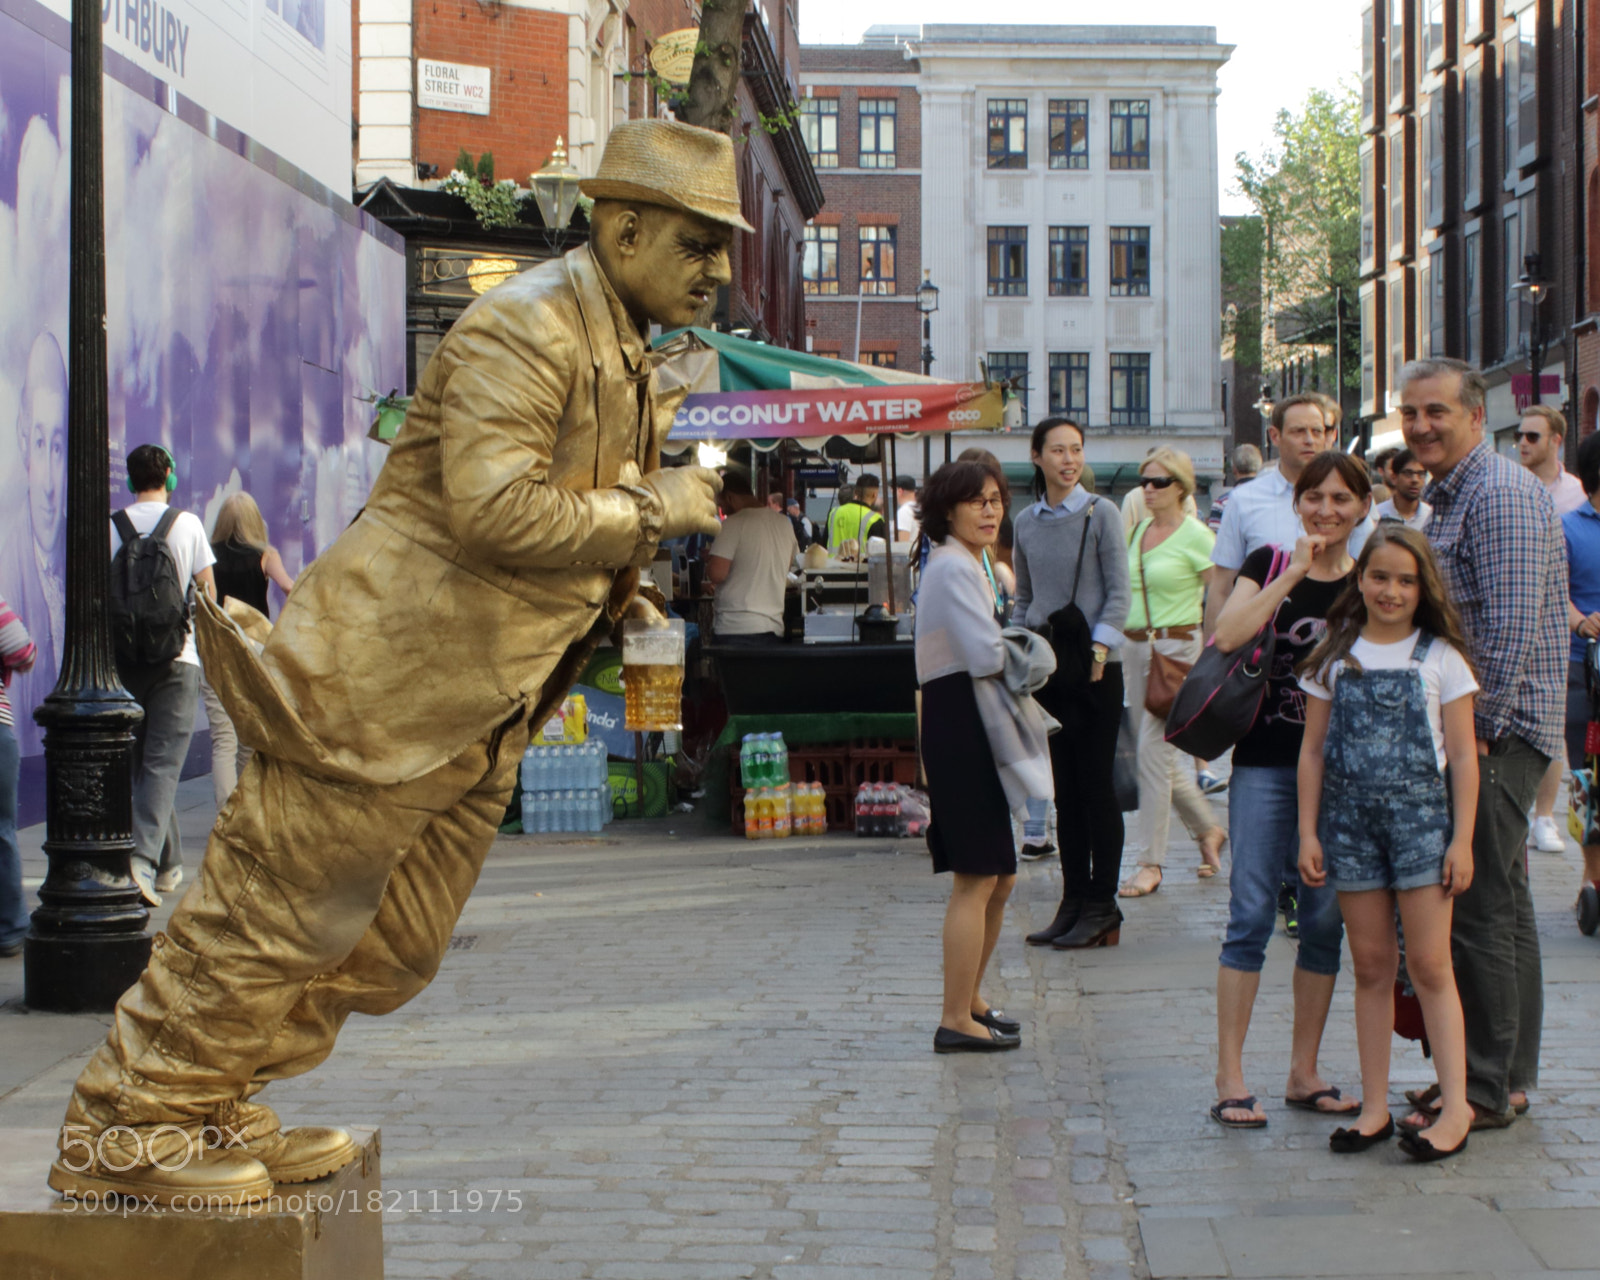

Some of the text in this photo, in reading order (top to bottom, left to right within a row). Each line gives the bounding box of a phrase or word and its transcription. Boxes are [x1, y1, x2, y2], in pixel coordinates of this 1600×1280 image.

[424, 64, 460, 80] FLORAL
[424, 79, 484, 99] STREET WC2
[672, 398, 923, 427] COCONUT WATER
